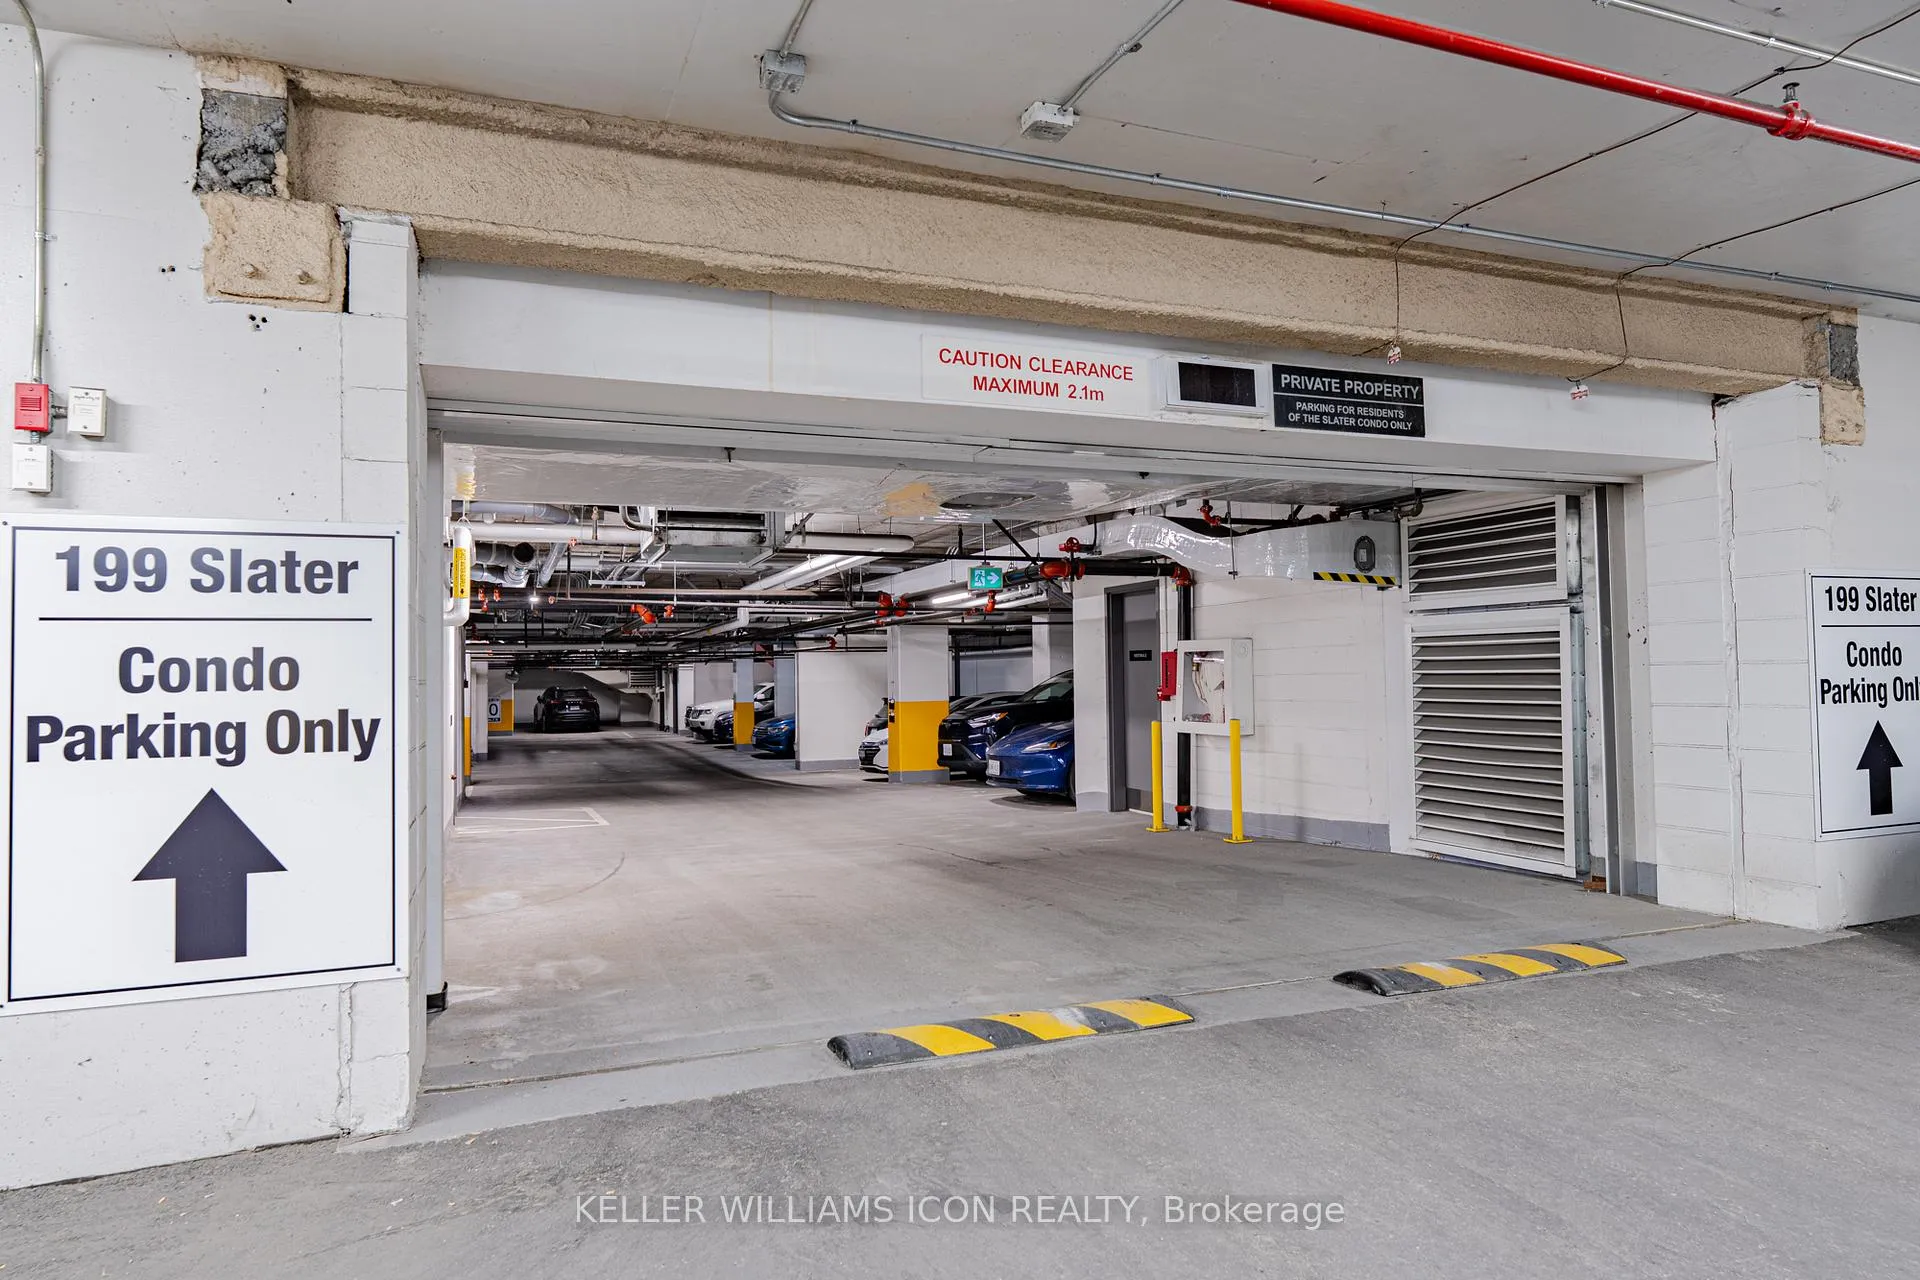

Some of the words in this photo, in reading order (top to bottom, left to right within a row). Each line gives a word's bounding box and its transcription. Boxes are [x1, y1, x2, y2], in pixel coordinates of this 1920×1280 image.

[938, 348, 1022, 370] CAUTION
[1028, 356, 1134, 381] CLEARANCE
[973, 375, 1060, 397] MAXIMUM
[1067, 384, 1105, 401] 2.1m
[1280, 374, 1341, 393] PRIVATE
[1344, 379, 1420, 400] PROPERTY
[1288, 412, 1300, 422] OF
[1302, 413, 1320, 424] THE
[1322, 415, 1355, 427] SLATER
[1357, 418, 1389, 429] CONDO
[1390, 421, 1413, 431] ONLY
[1296, 401, 1335, 414] PARKING
[1337, 405, 1355, 416] FOR
[1357, 407, 1404, 419] RESIDENTS
[55, 545, 168, 593] 199
[190, 547, 359, 594] Slater
[1825, 585, 1859, 612] 199
[1865, 585, 1917, 612] Slater
[1846, 641, 1902, 667] Condo
[118, 646, 301, 693] Condo
[1820, 677, 1888, 708] Parking
[1893, 676, 1920, 702] Onl
[26, 711, 247, 768] Parking
[265, 708, 382, 762] Only
